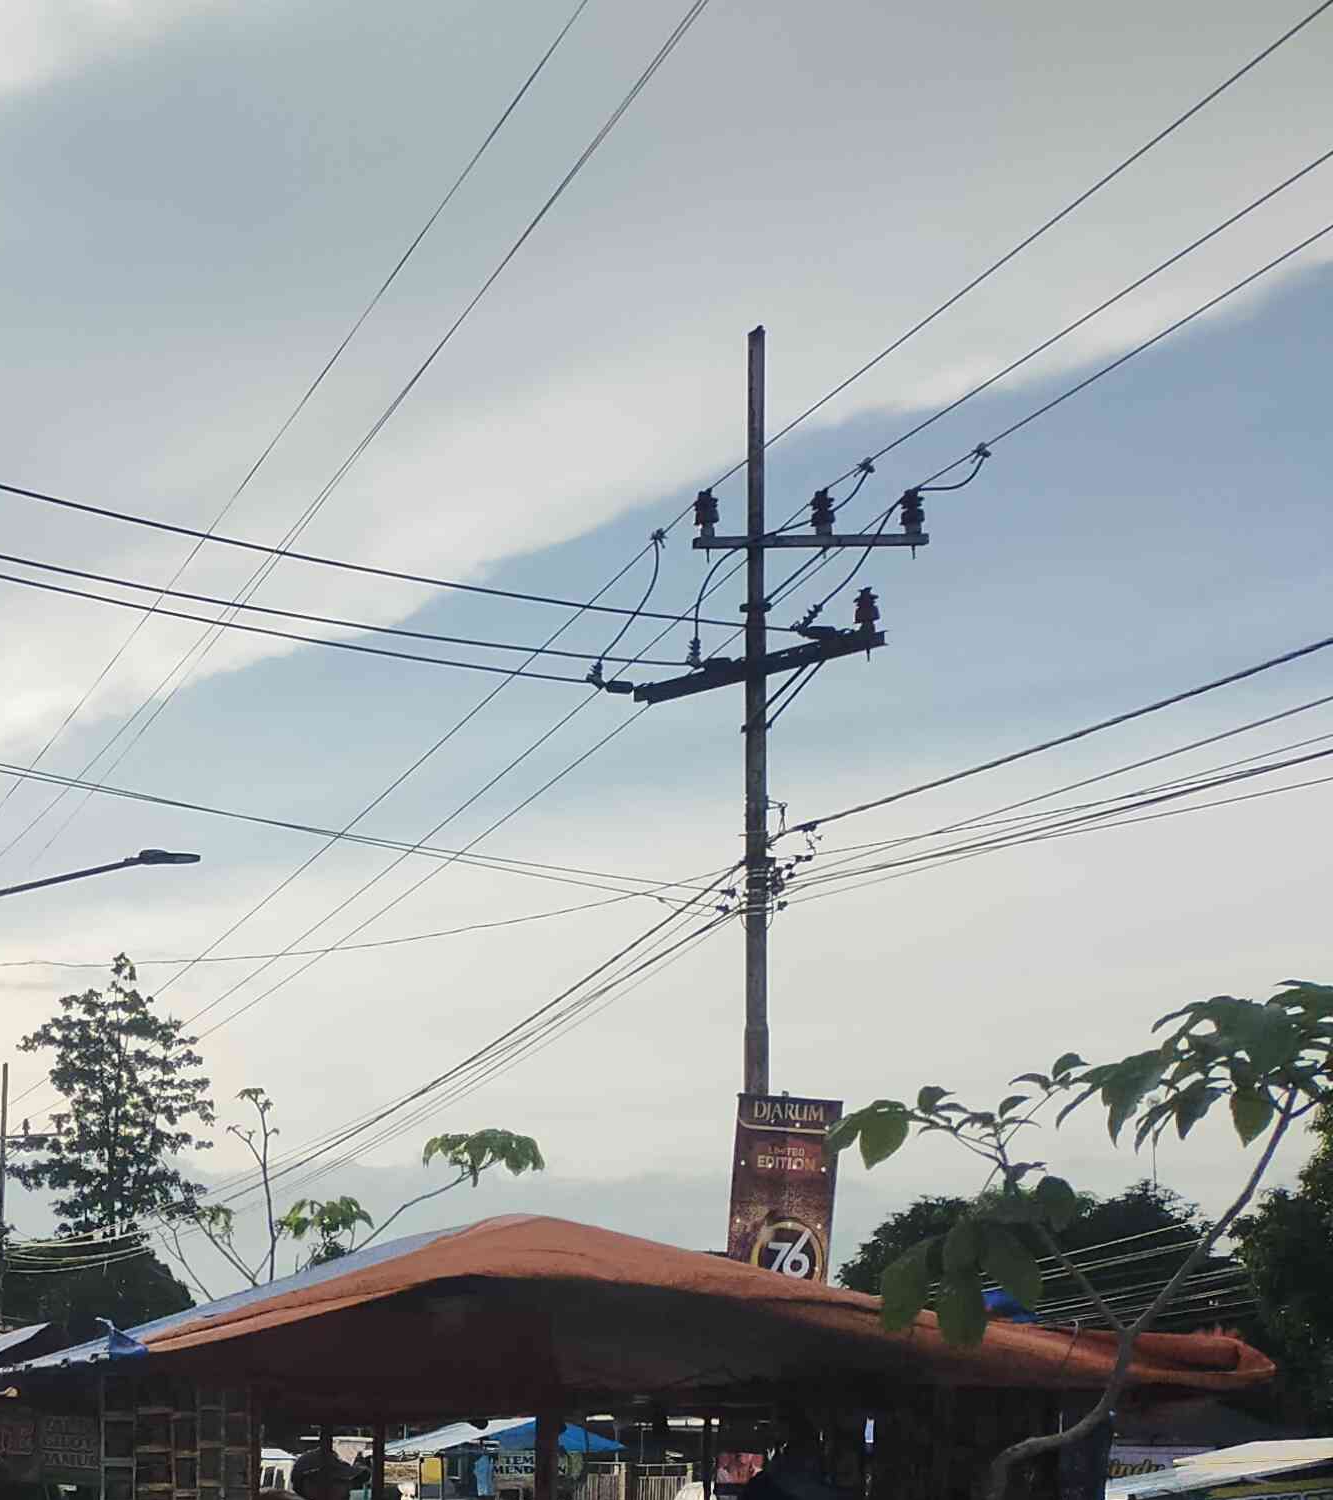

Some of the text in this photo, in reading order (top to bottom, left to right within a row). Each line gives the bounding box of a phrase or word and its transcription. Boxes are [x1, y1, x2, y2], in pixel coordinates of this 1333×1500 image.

[753, 1100, 825, 1122] DJARUM
[757, 1154, 817, 1173] EDITION
[766, 1229, 810, 1279] 76
